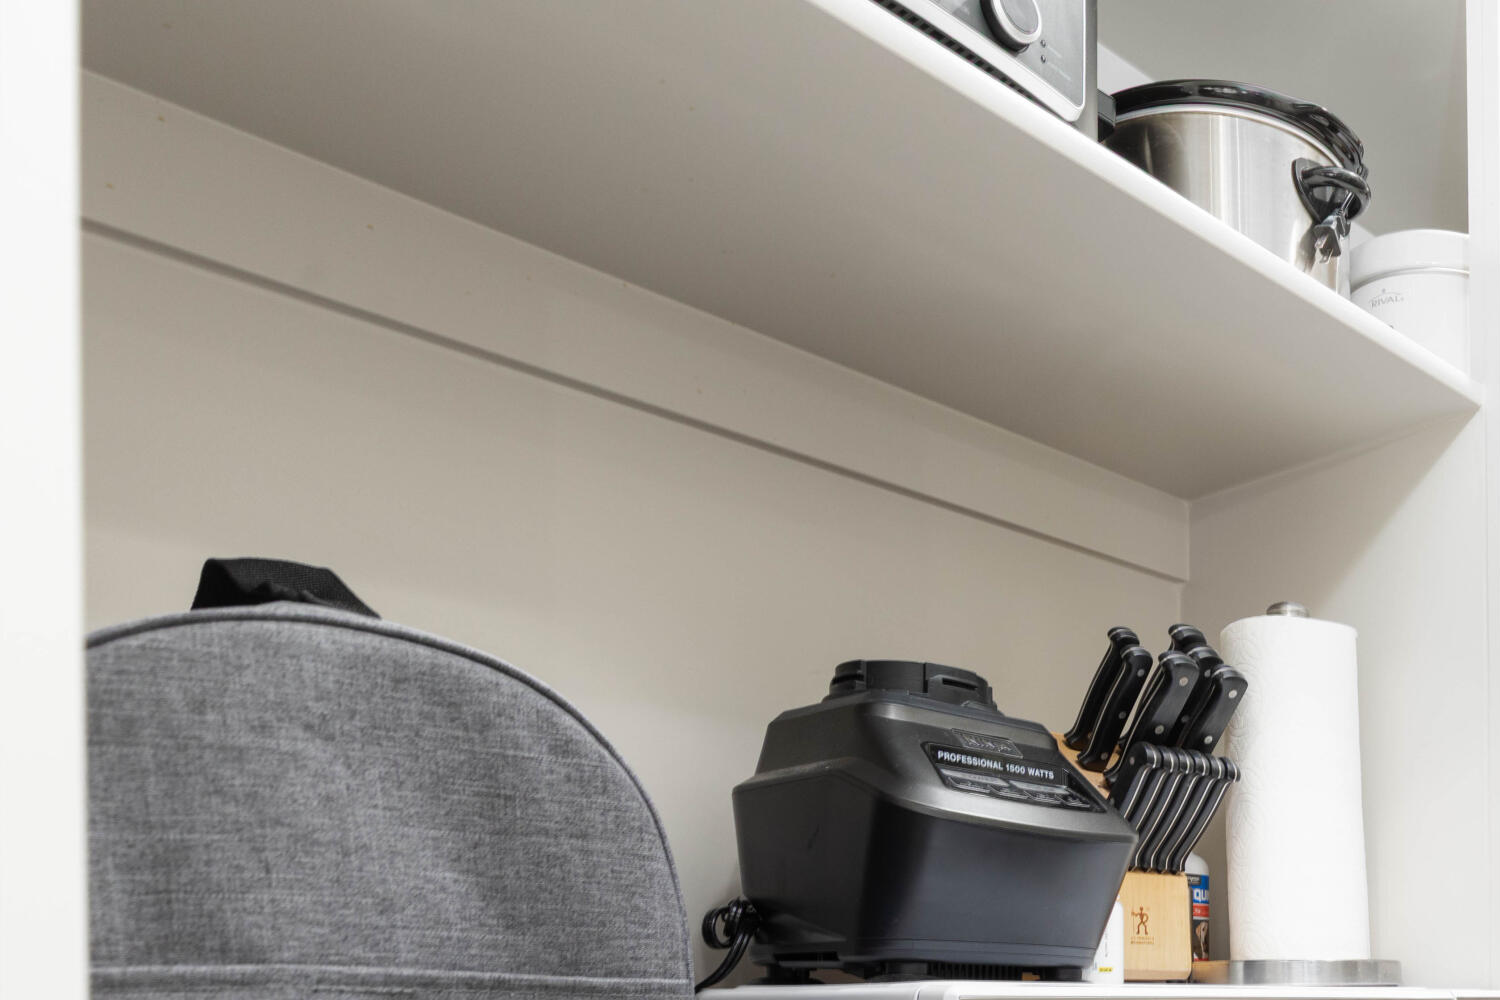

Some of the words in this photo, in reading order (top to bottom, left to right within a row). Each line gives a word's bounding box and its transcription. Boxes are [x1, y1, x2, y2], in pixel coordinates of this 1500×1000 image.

[937, 749, 1003, 772] PROFESSIONAL
[1005, 761, 1026, 775] 1500
[1027, 765, 1055, 780] WATTS
